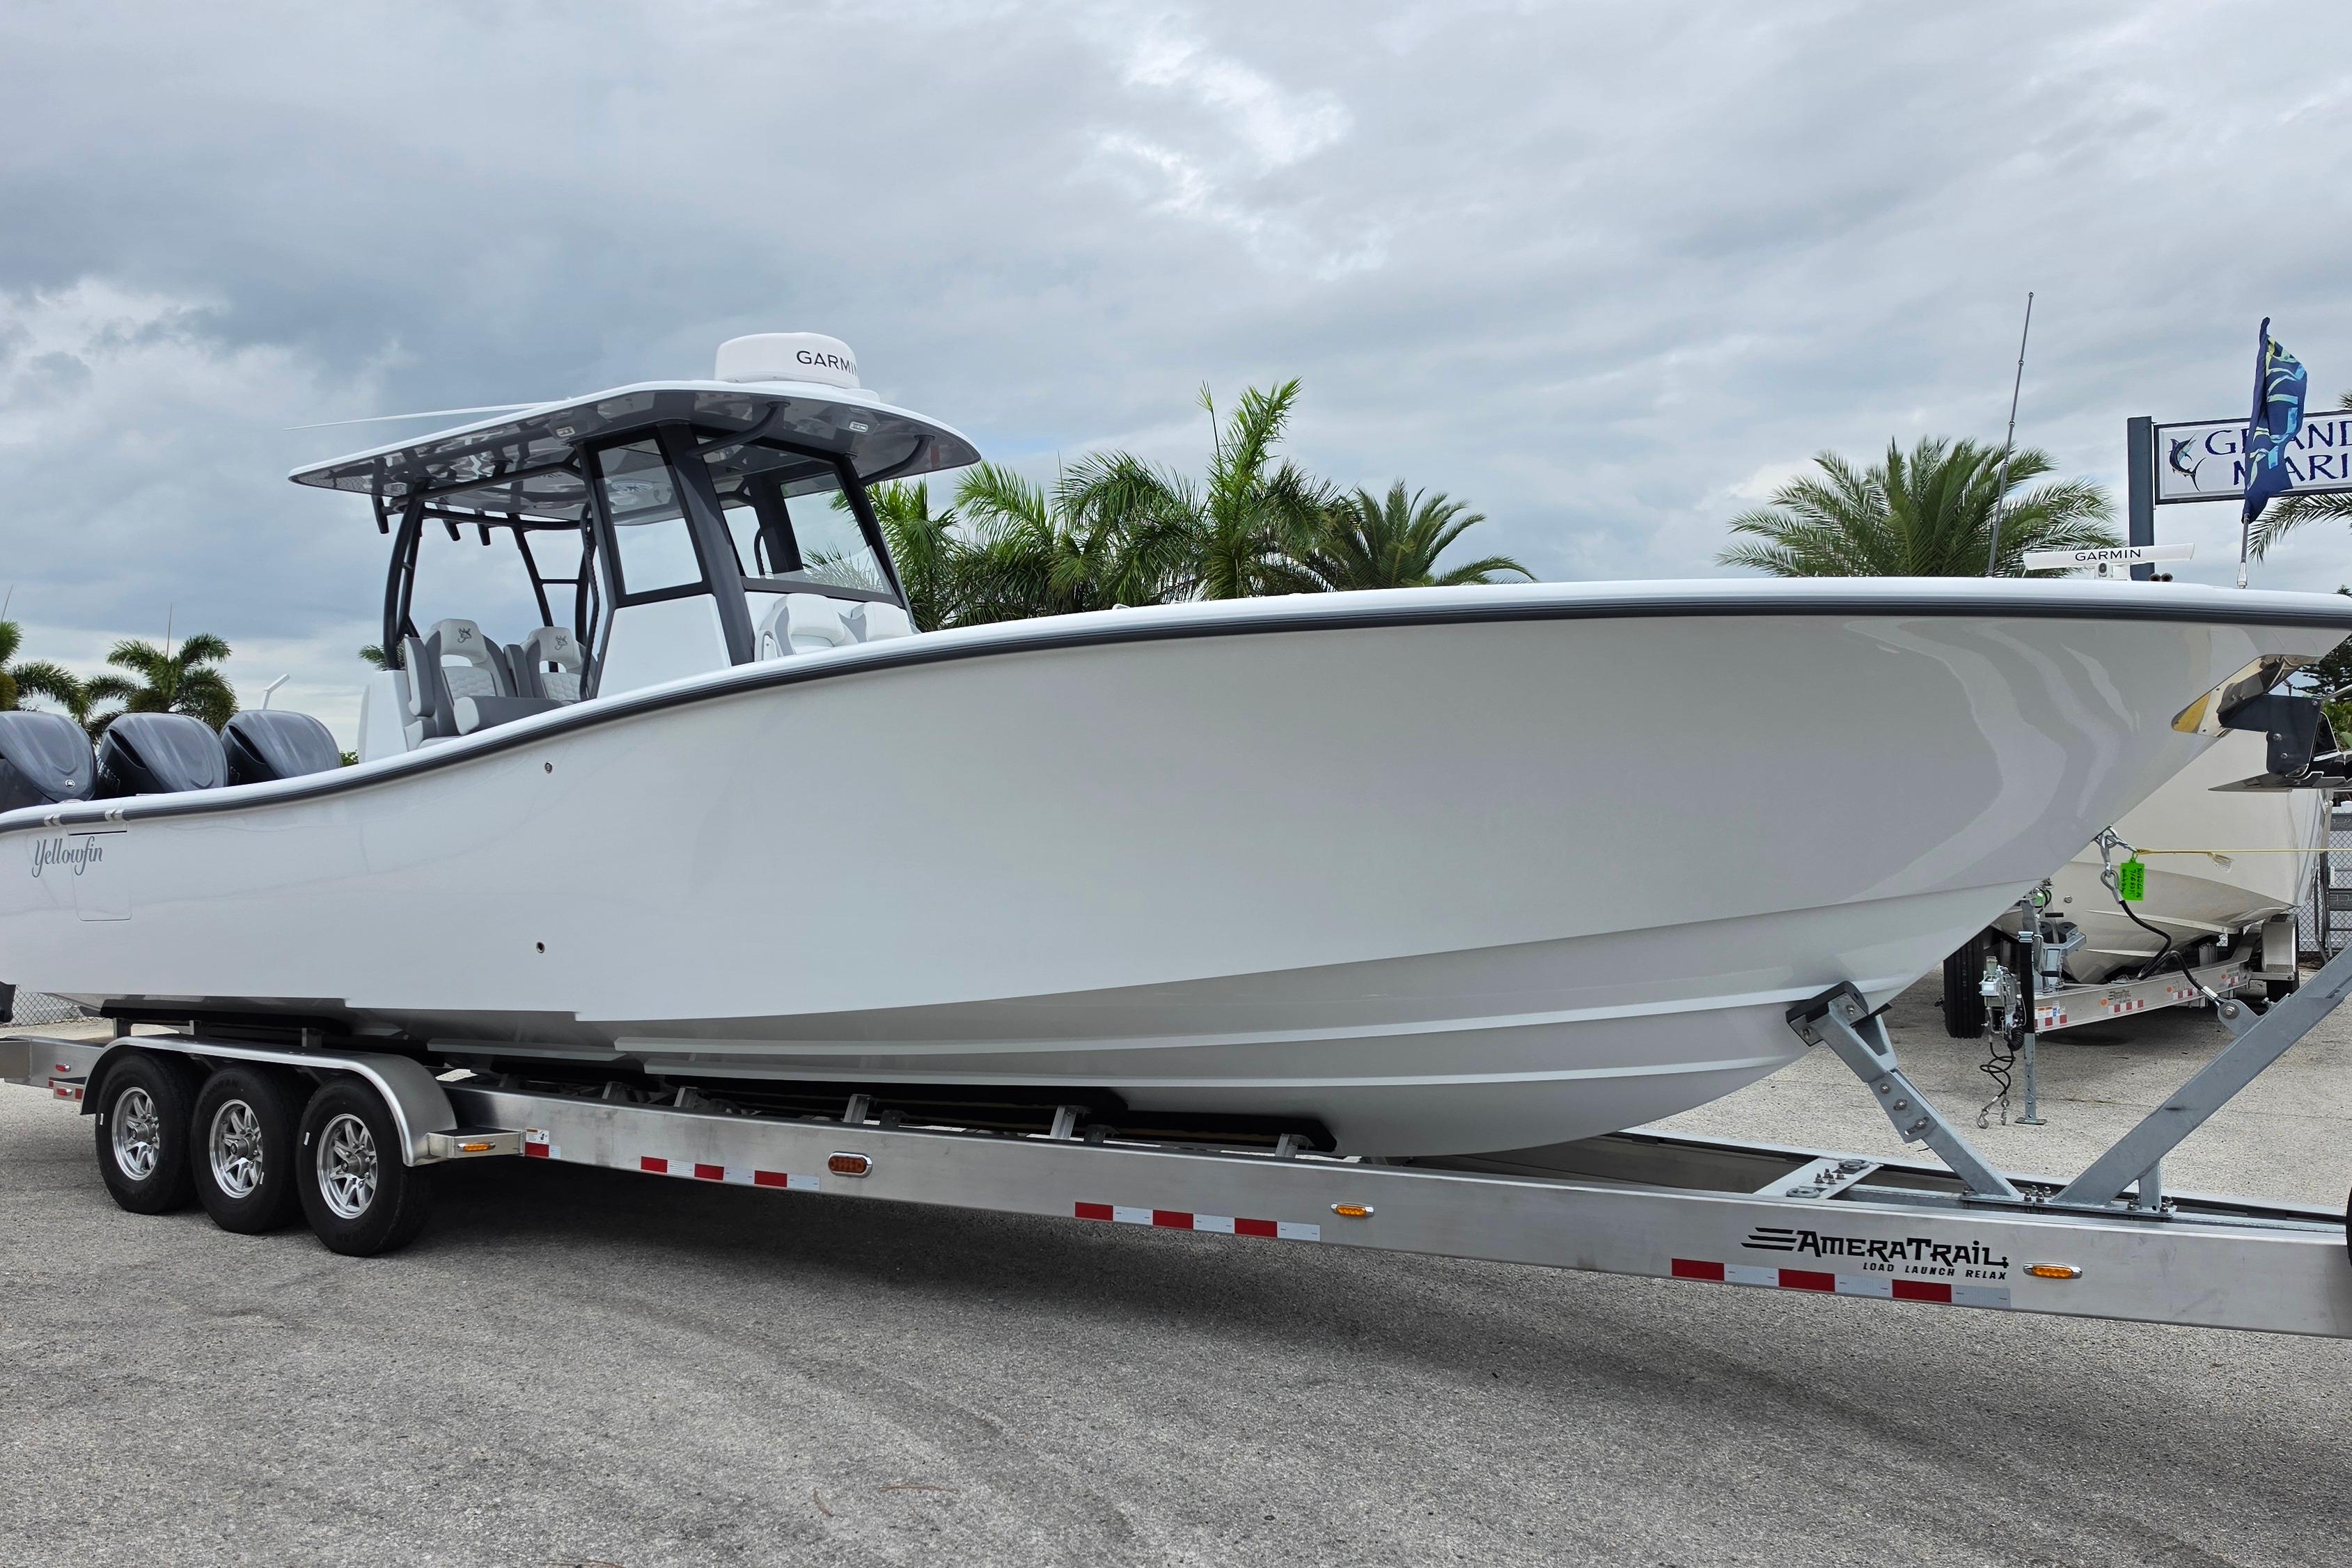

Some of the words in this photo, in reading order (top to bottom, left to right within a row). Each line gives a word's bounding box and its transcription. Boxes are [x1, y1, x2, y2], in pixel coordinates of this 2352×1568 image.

[2075, 549, 2141, 561] GARMIN
[31, 836, 103, 878] Yellowfin
[1863, 1262, 1895, 1273] LOAD
[1905, 1265, 1954, 1277] LAUNCH
[1965, 1269, 2007, 1280] RELAX
